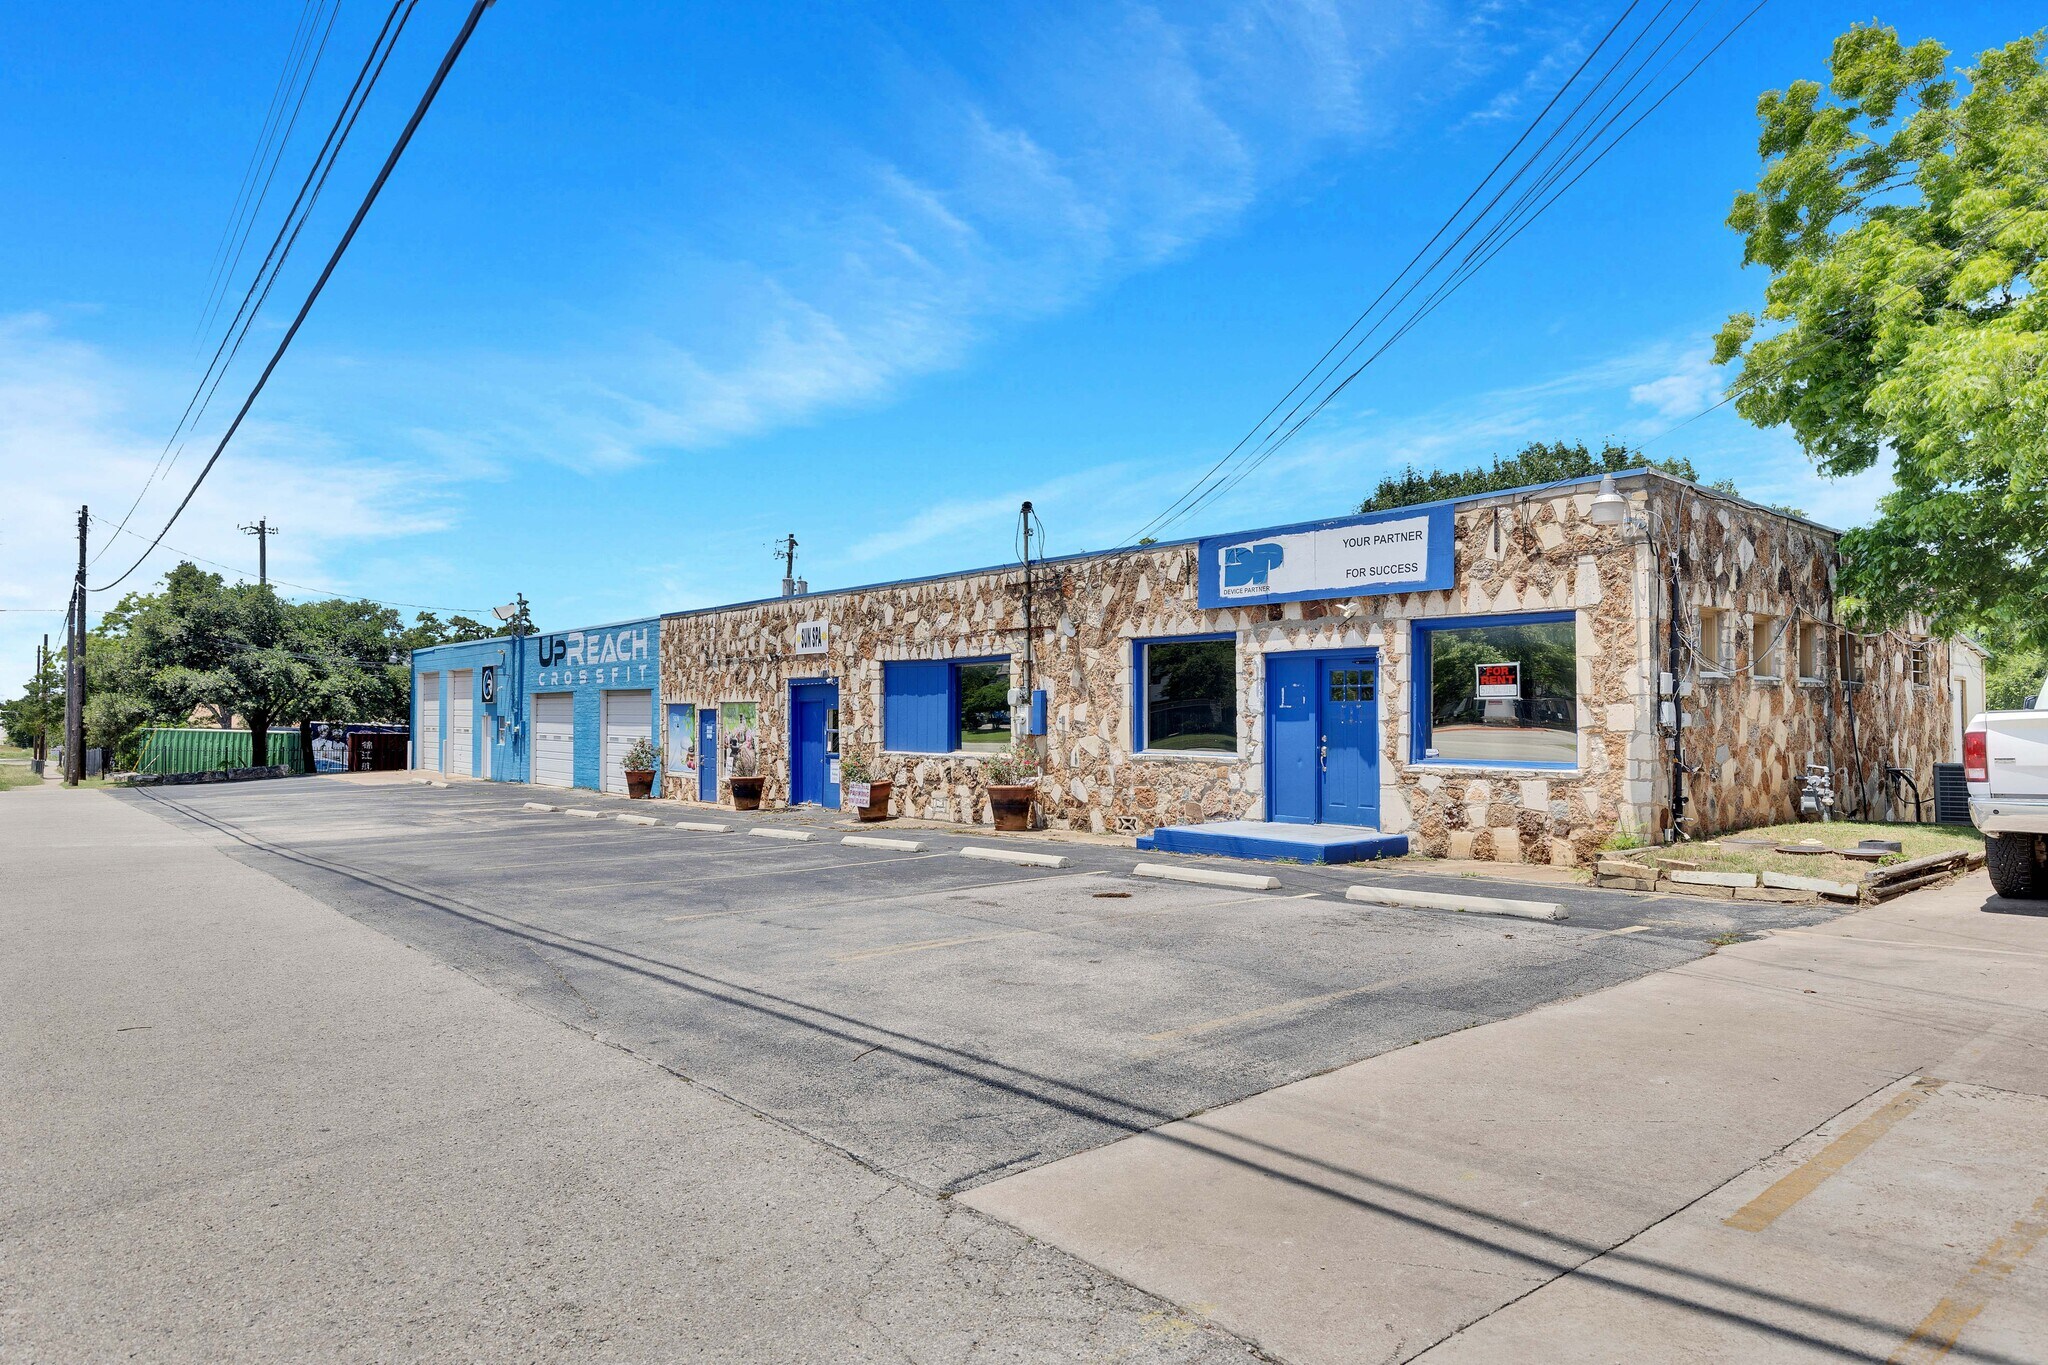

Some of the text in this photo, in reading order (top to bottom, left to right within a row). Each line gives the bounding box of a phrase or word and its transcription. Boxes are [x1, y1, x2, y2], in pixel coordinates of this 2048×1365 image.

[1343, 530, 1423, 548] YOUR PARTNER
[1346, 562, 1418, 578] FOR SUCCESS
[1244, 585, 1270, 593] PARTNER
[801, 626, 822, 648] SUN SPA
[539, 664, 647, 686] CROSSFIT
[1486, 666, 1509, 675] FOR
[1481, 675, 1515, 684] RENT
